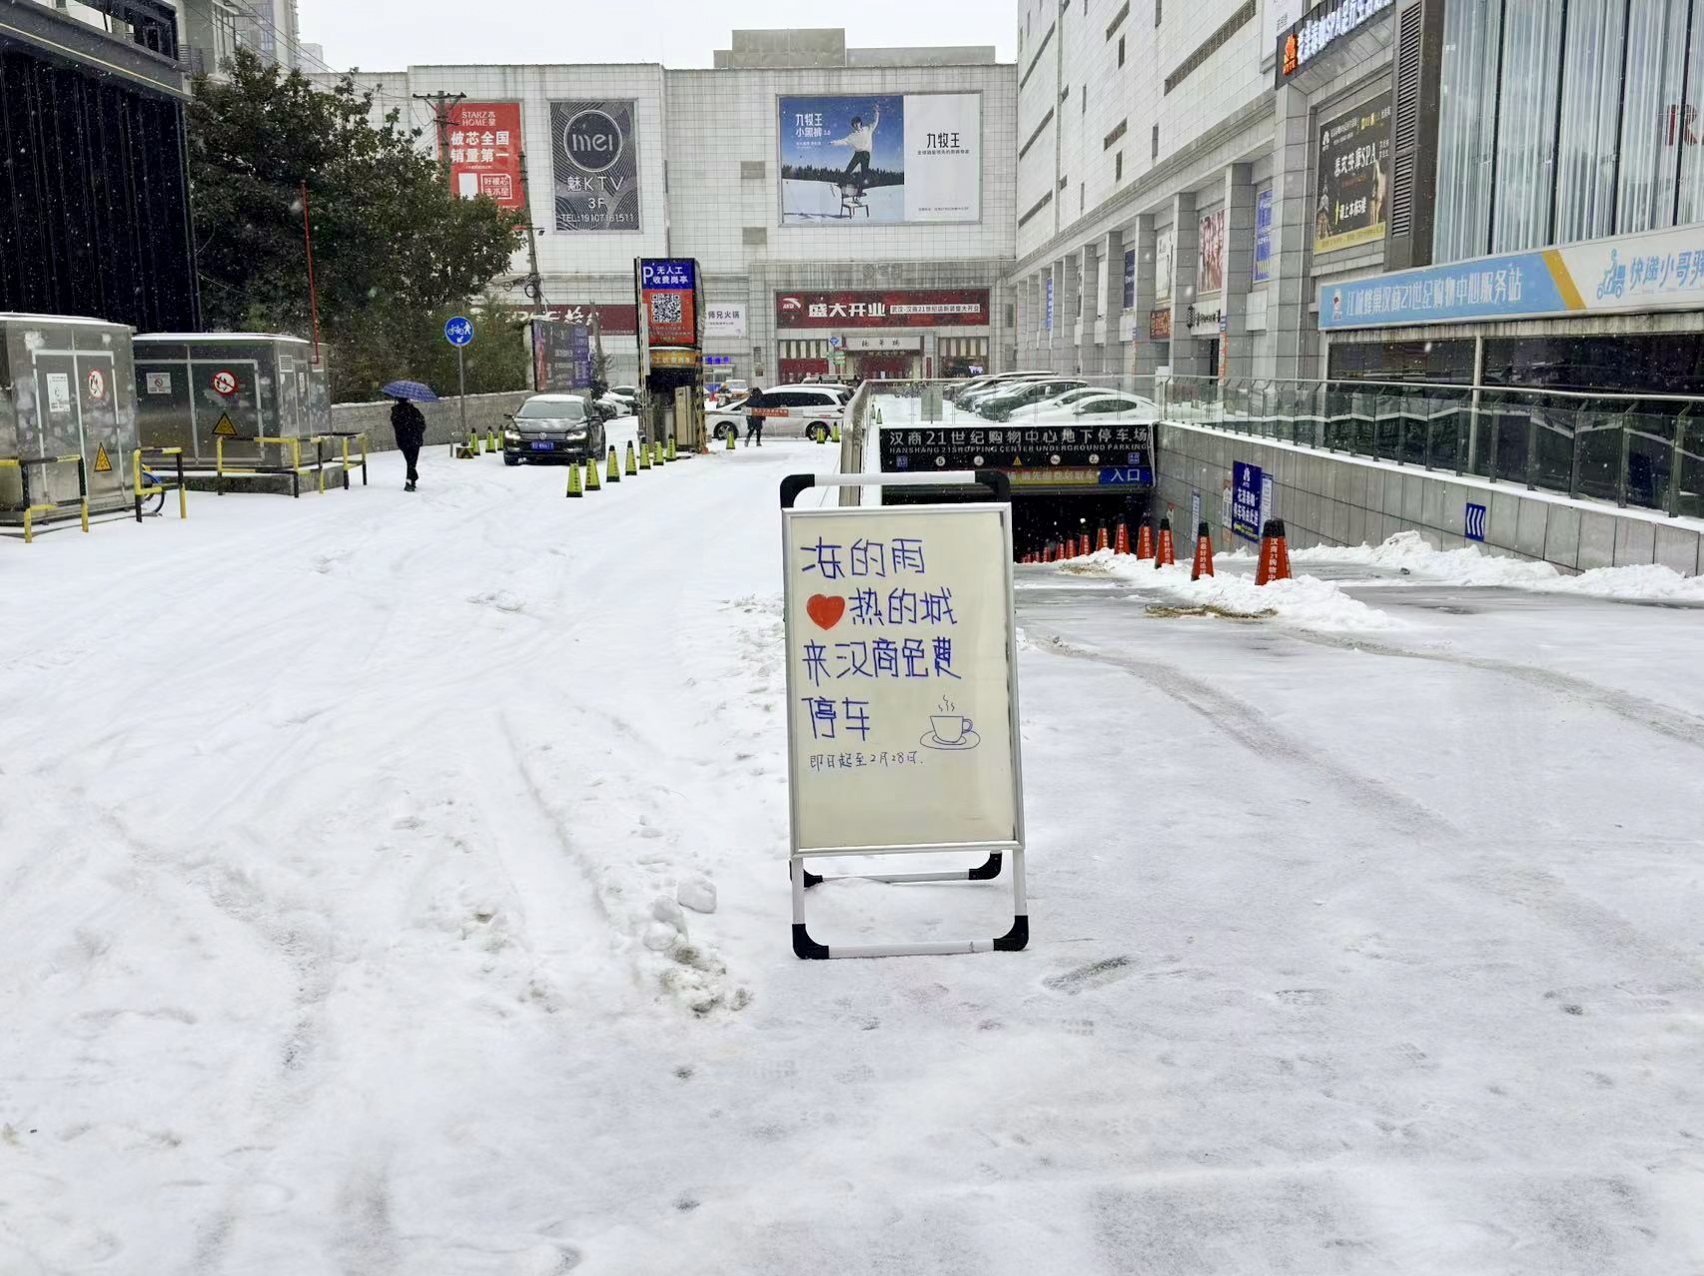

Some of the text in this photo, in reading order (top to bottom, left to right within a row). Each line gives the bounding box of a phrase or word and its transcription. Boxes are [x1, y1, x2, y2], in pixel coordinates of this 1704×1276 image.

[795, 113, 823, 126] 九牧王
[451, 131, 509, 146] 被芯全国
[572, 134, 613, 151] mei
[926, 132, 960, 148] 九牧王
[451, 148, 509, 163] 销量第一
[588, 197, 605, 209] 3F
[642, 266, 654, 284] P
[657, 266, 683, 275] 无人工
[653, 275, 688, 284] 收费岗亭
[808, 302, 886, 317] 盛大开业
[889, 428, 1148, 446] 汉商21世纪购物中心地下停车场
[1107, 442, 1147, 451] PARKING
[1110, 468, 1141, 482] 入口
[800, 536, 925, 579] 冻的雨
[848, 586, 958, 626] 热的城
[802, 635, 962, 687] 来汉商免费
[801, 696, 871, 741] 停车
